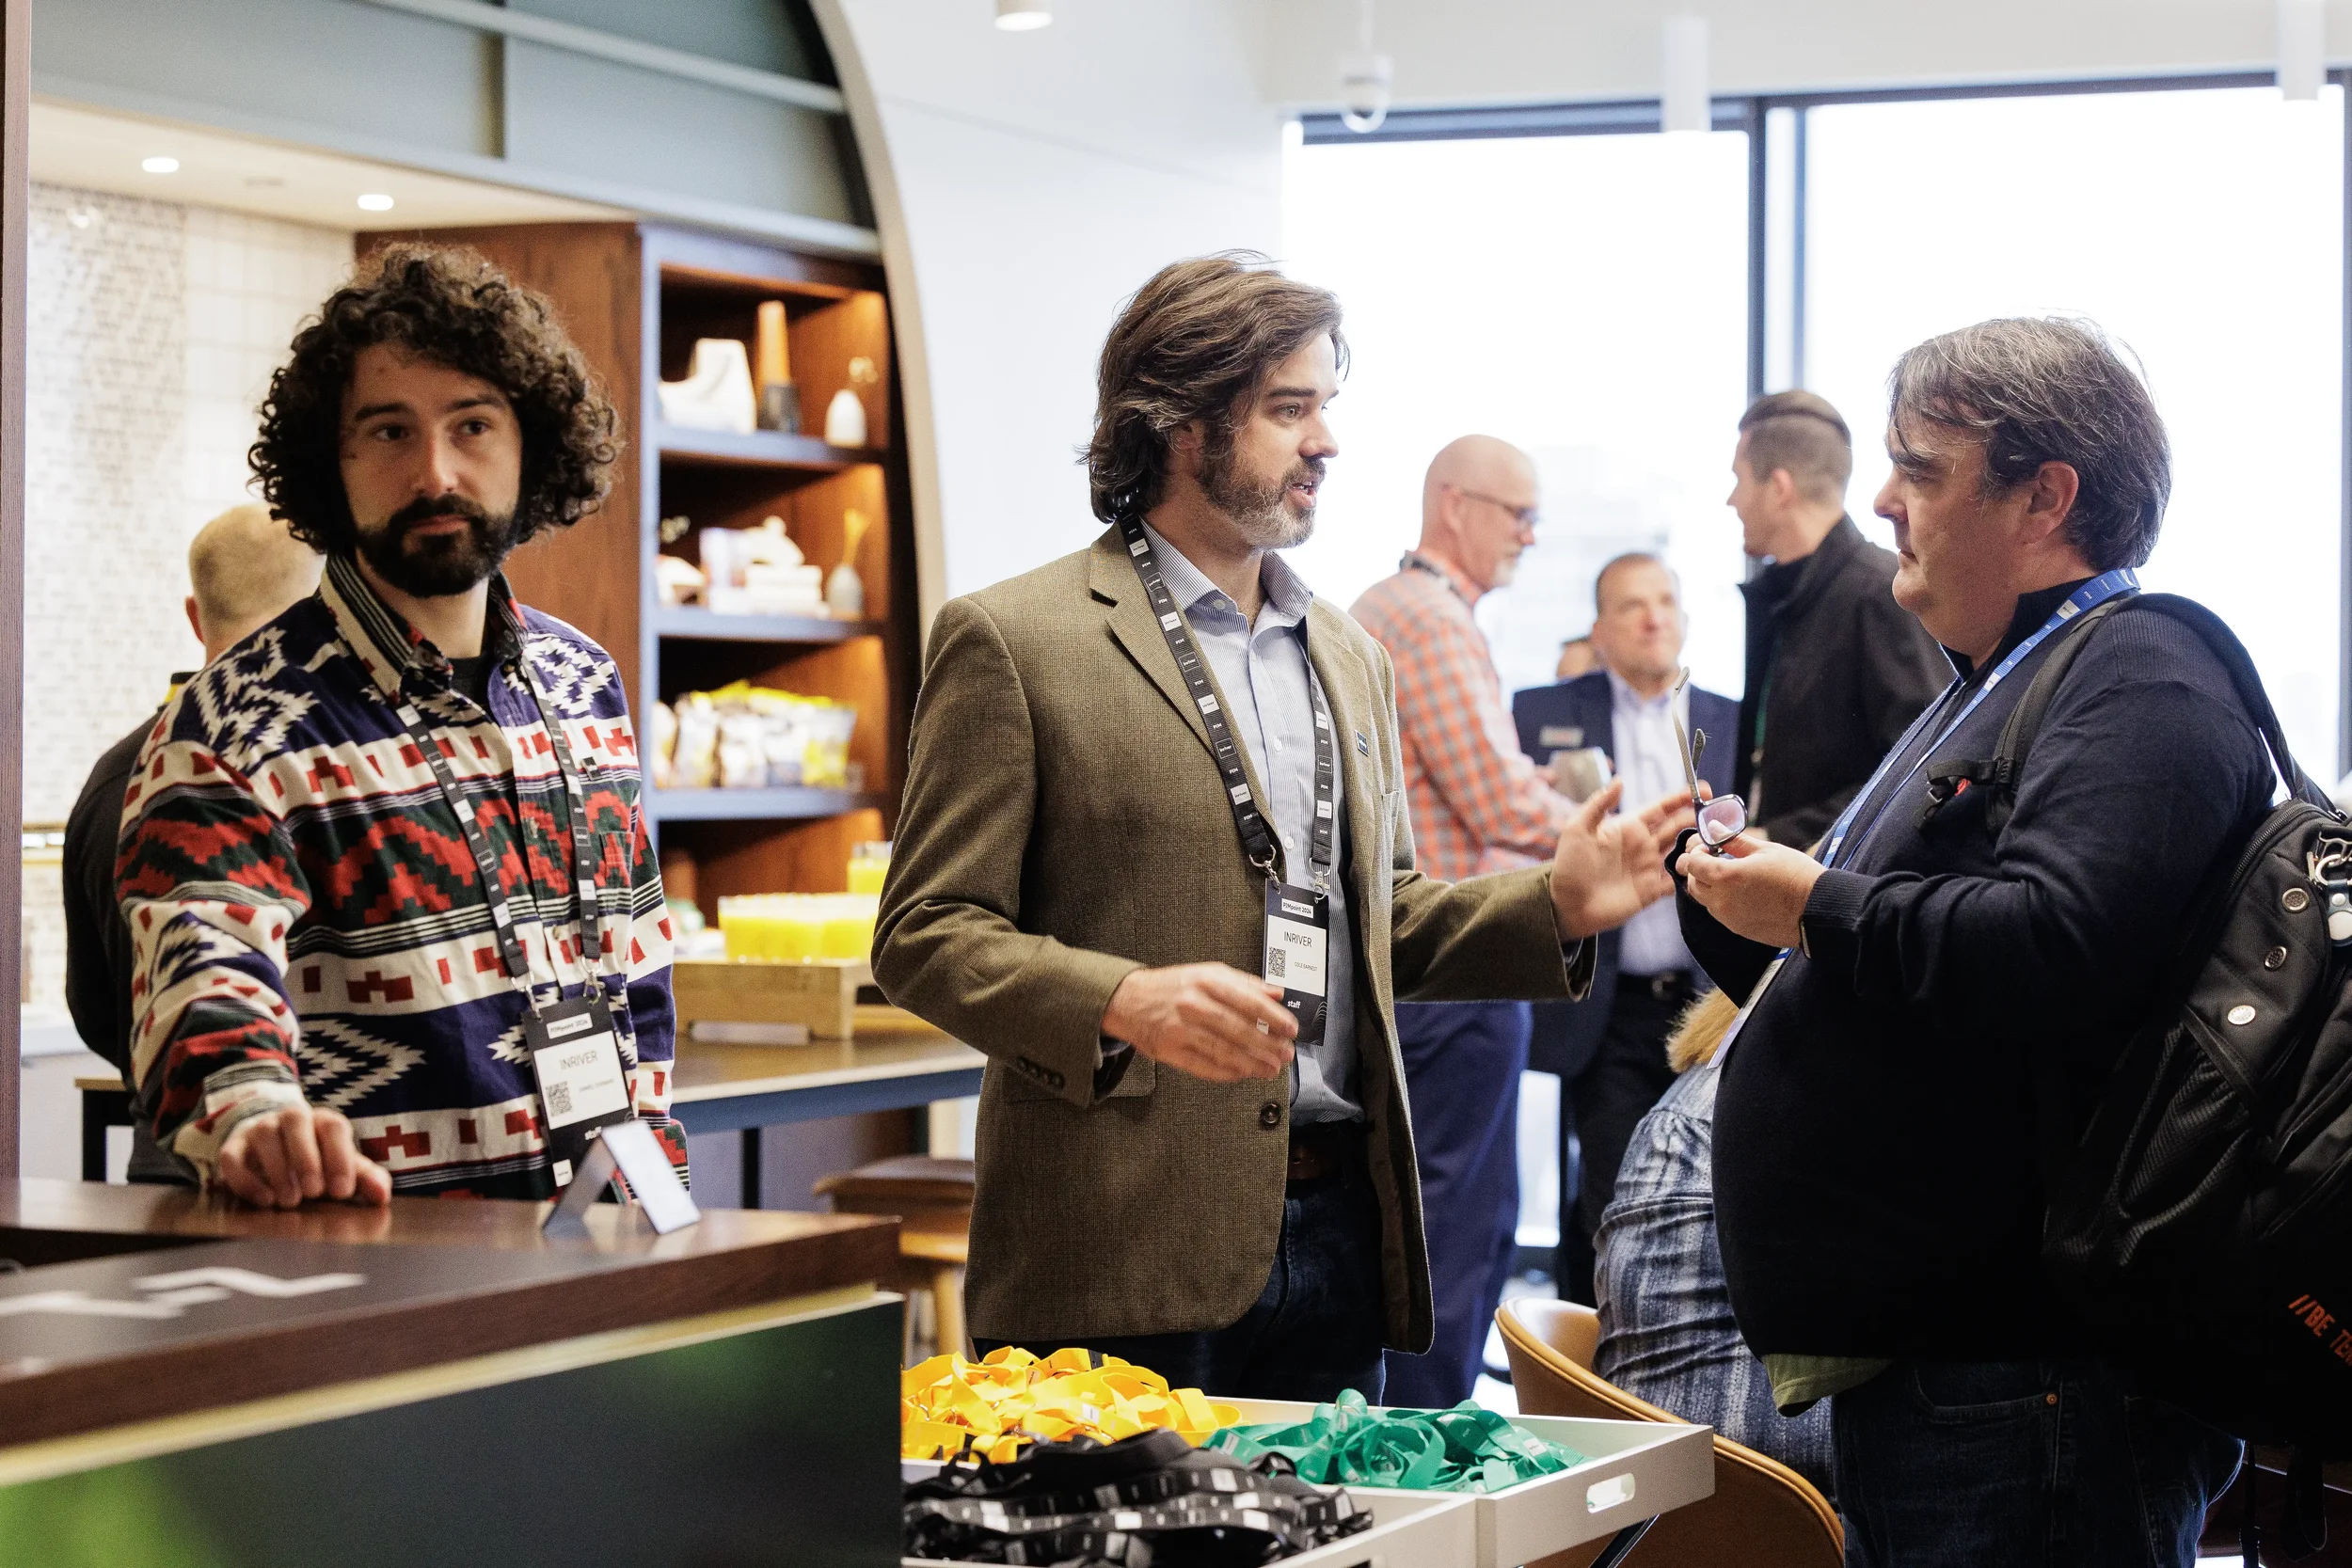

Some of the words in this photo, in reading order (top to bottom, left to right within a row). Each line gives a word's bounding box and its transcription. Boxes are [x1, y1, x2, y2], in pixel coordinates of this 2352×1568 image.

[1283, 930, 1312, 948] INRIVER
[1287, 1000, 1301, 1009] staff
[559, 1050, 598, 1070] INRIVER
